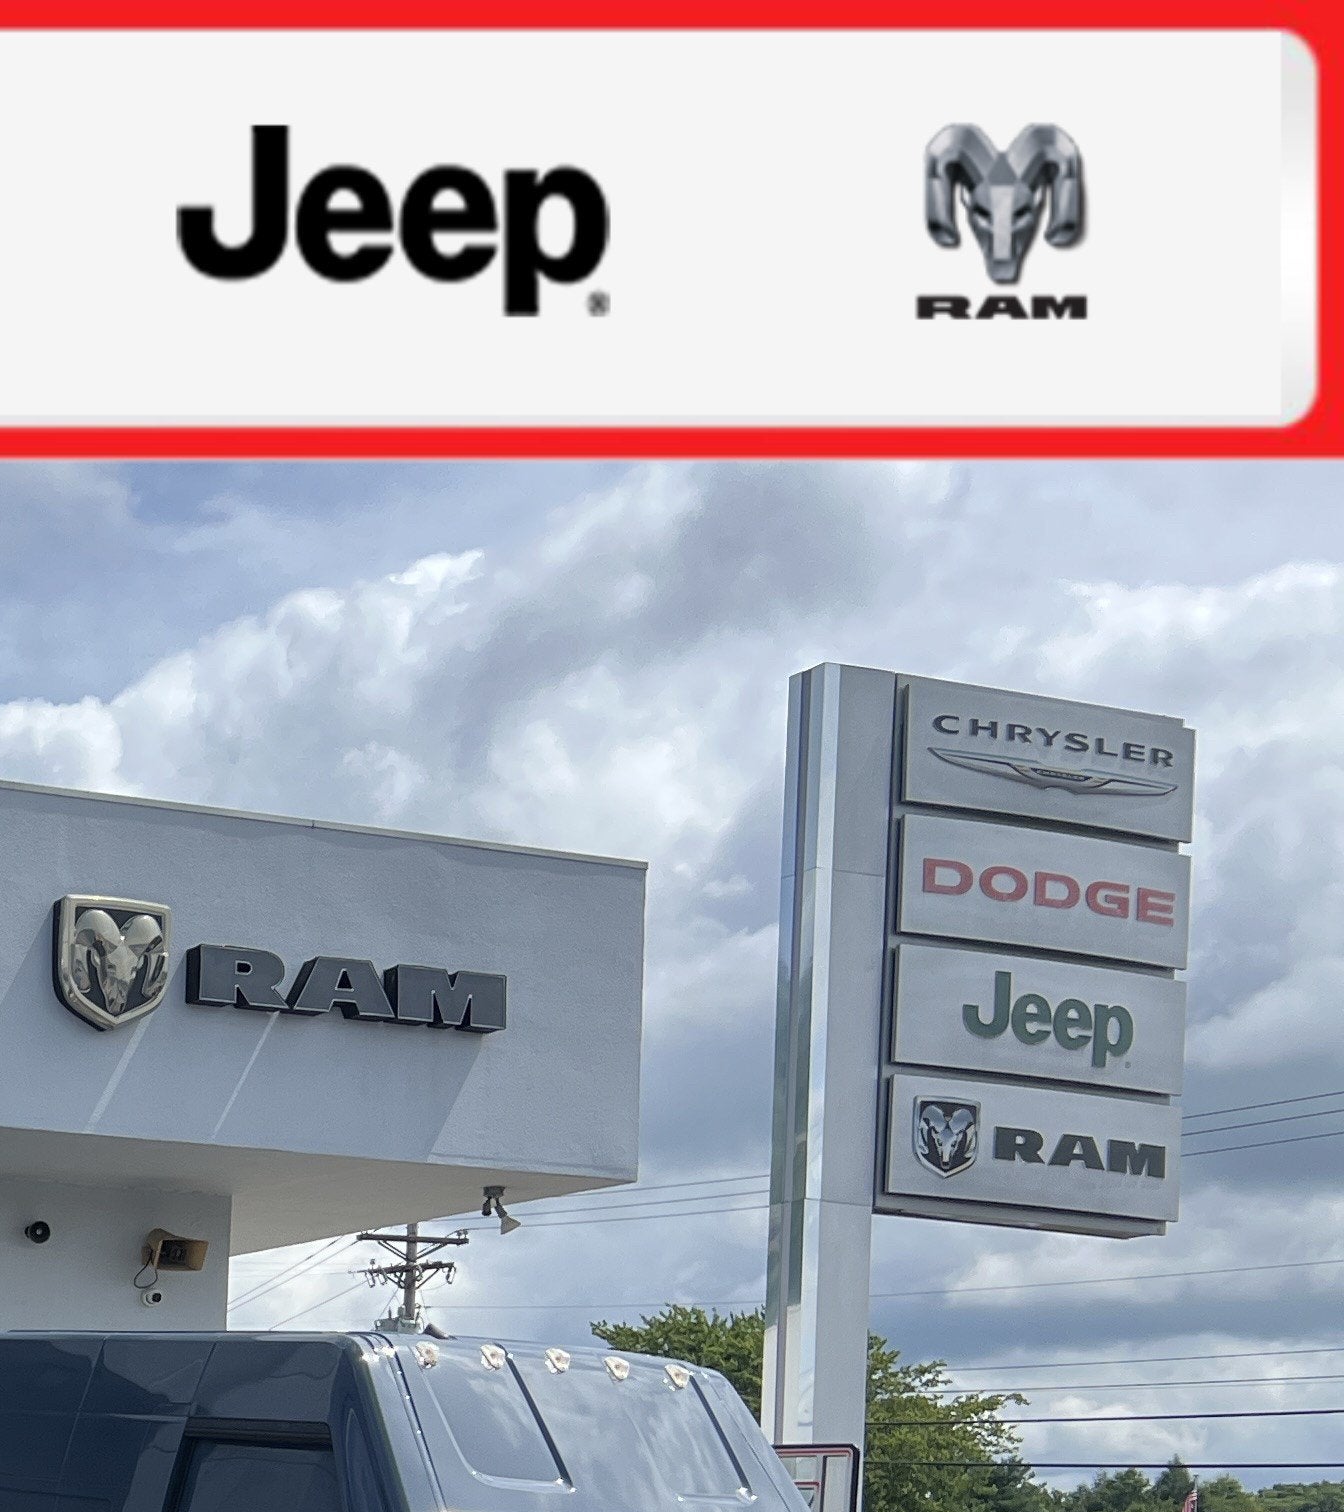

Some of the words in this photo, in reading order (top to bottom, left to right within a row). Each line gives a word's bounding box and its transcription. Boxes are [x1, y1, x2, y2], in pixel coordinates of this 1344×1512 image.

[931, 713, 1175, 768] CHRYSLER
[922, 857, 1176, 928] DODGE
[185, 943, 508, 1034] RAM
[962, 970, 1135, 1069] Jeep
[993, 1125, 1166, 1180] RAM
